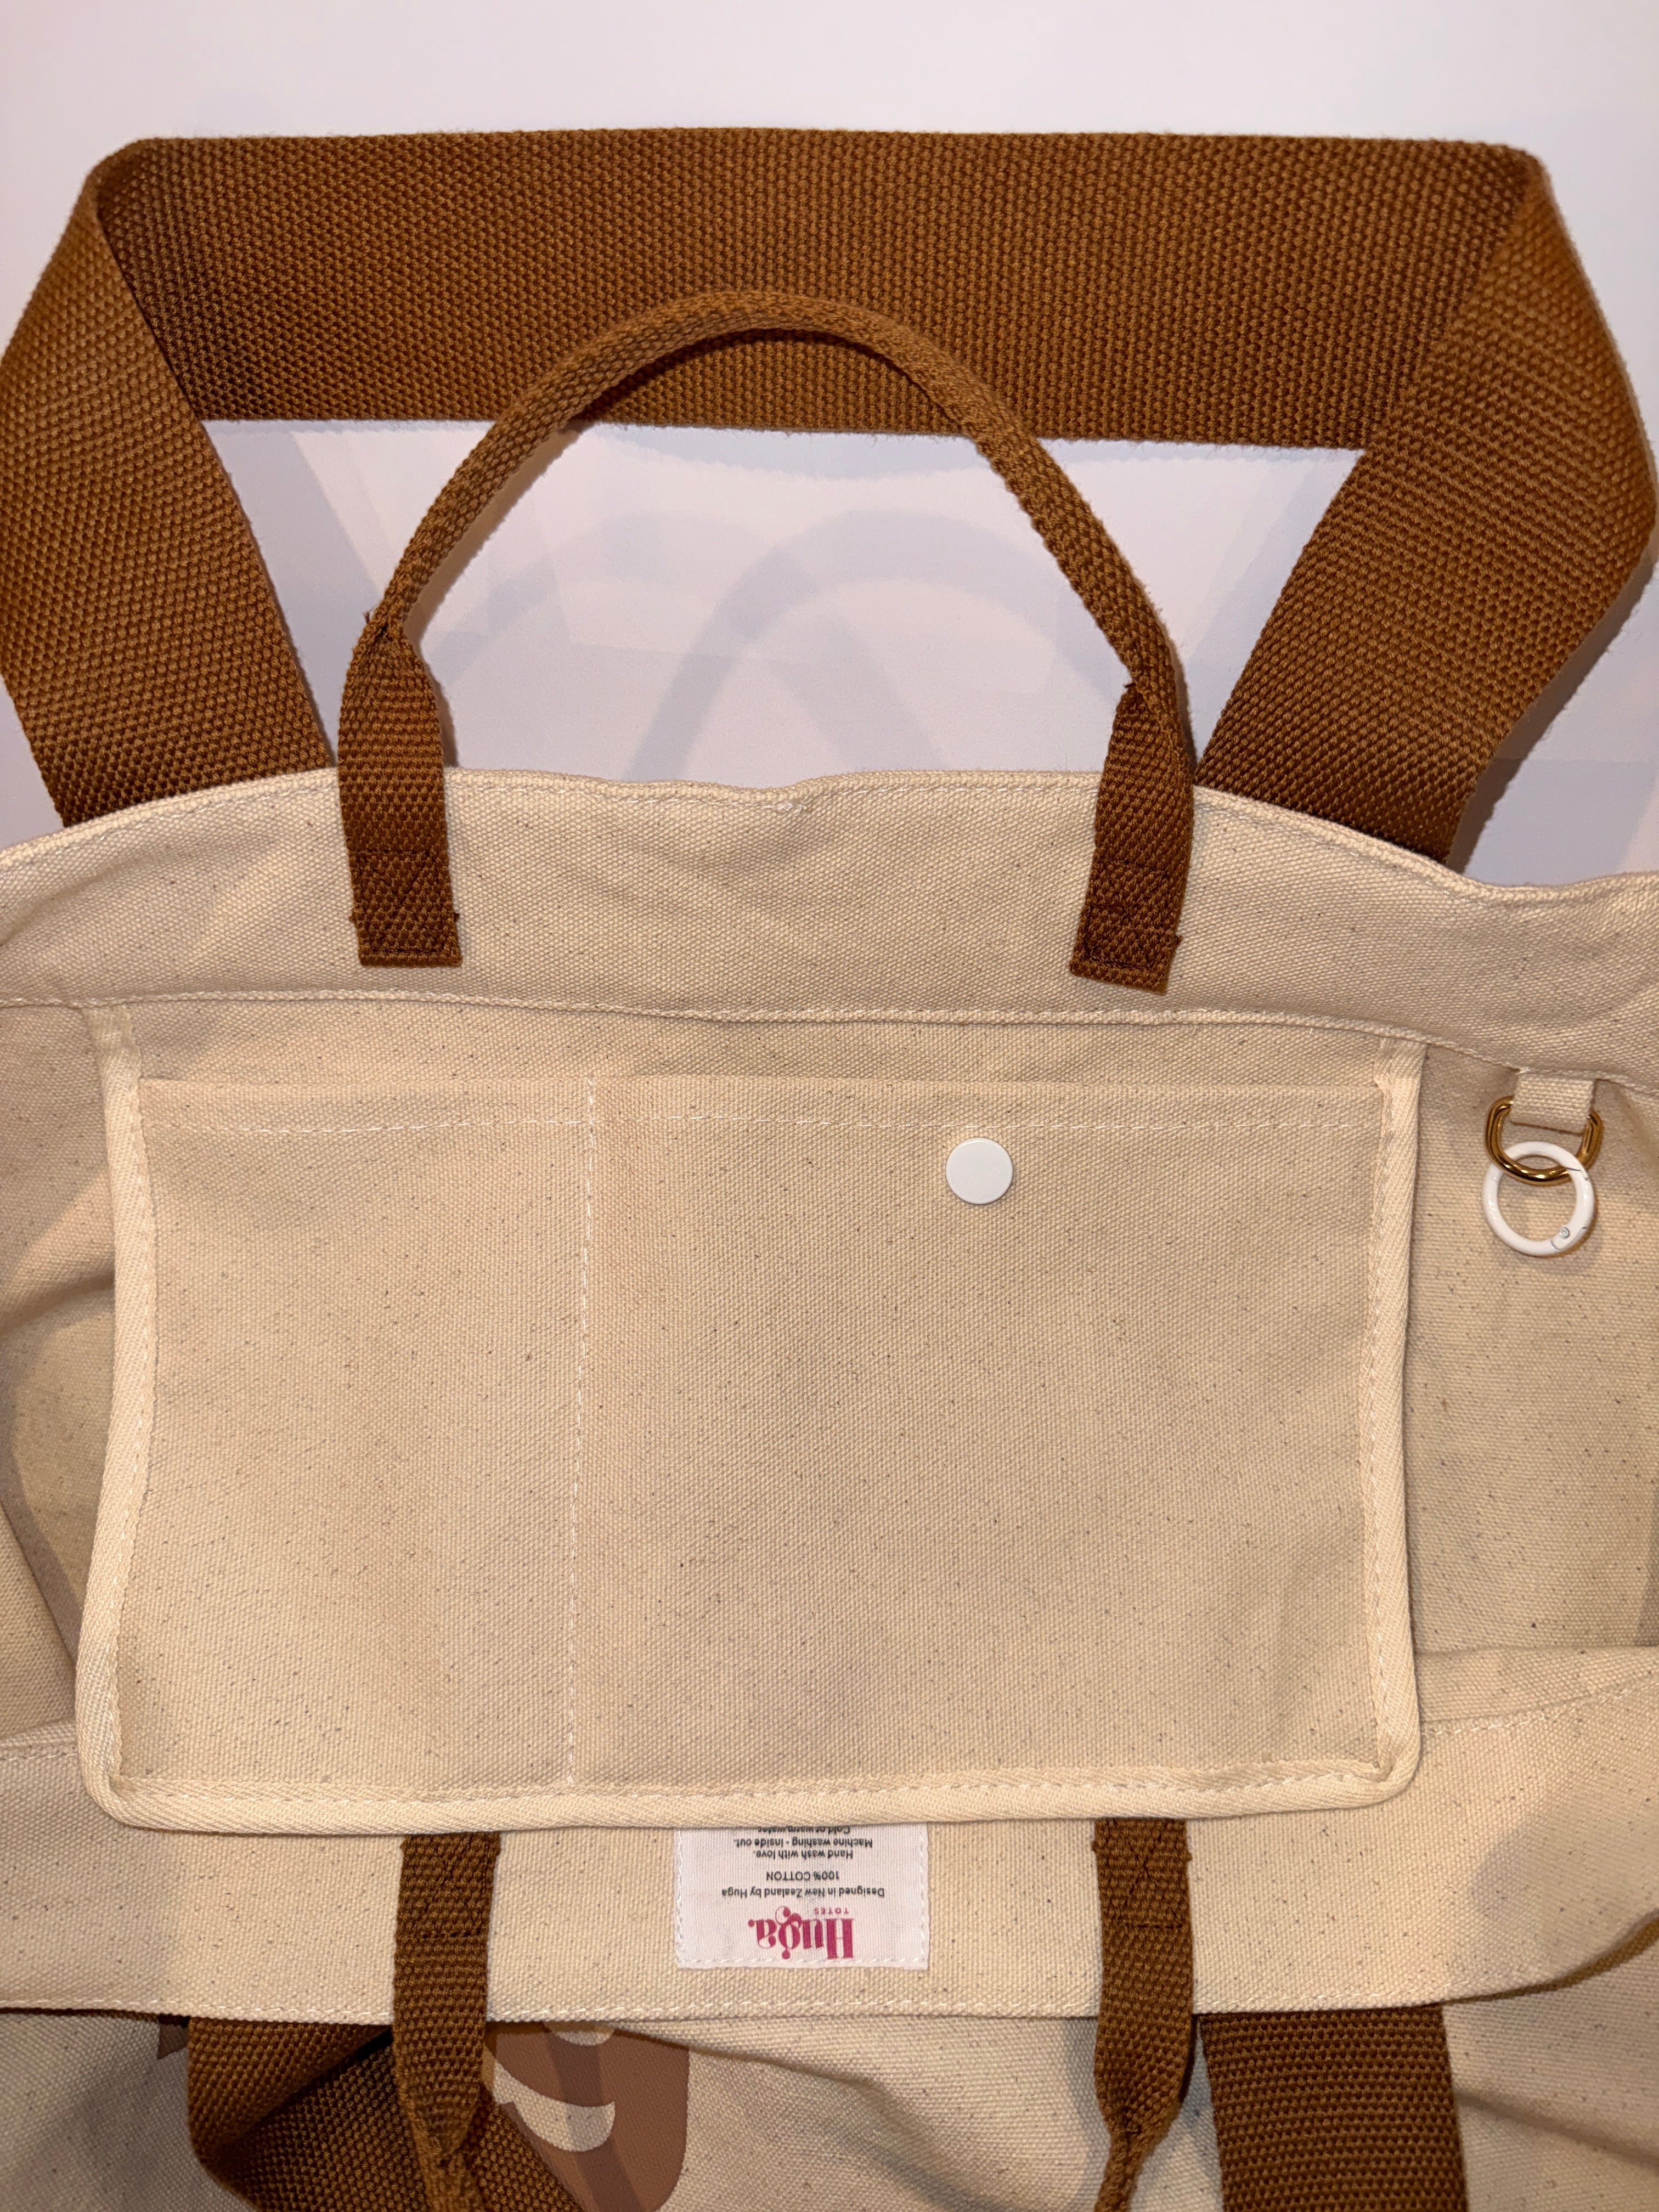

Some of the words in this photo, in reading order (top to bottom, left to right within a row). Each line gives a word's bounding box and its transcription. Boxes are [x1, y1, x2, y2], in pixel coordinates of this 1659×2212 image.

[828, 1825, 850, 1834] Cold
[733, 1838, 752, 1848] out.
[754, 1838, 783, 1848] inside
[792, 1837, 831, 1848] washing
[833, 1838, 873, 1848] Machine
[753, 1850, 776, 1860] love.
[778, 1850, 799, 1859] with
[801, 1850, 825, 1860] wash
[827, 1850, 853, 1859] Hand
[766, 1871, 810, 1881] COTTON
[814, 1870, 839, 1880] 100%
[721, 1886, 748, 1898] Huga
[750, 1886, 762, 1898] by
[764, 1887, 803, 1898] Zealand
[805, 1887, 825, 1897] New
[827, 1887, 836, 1897] in
[839, 1885, 885, 1897] Designed
[748, 1906, 854, 1959] Huga.
